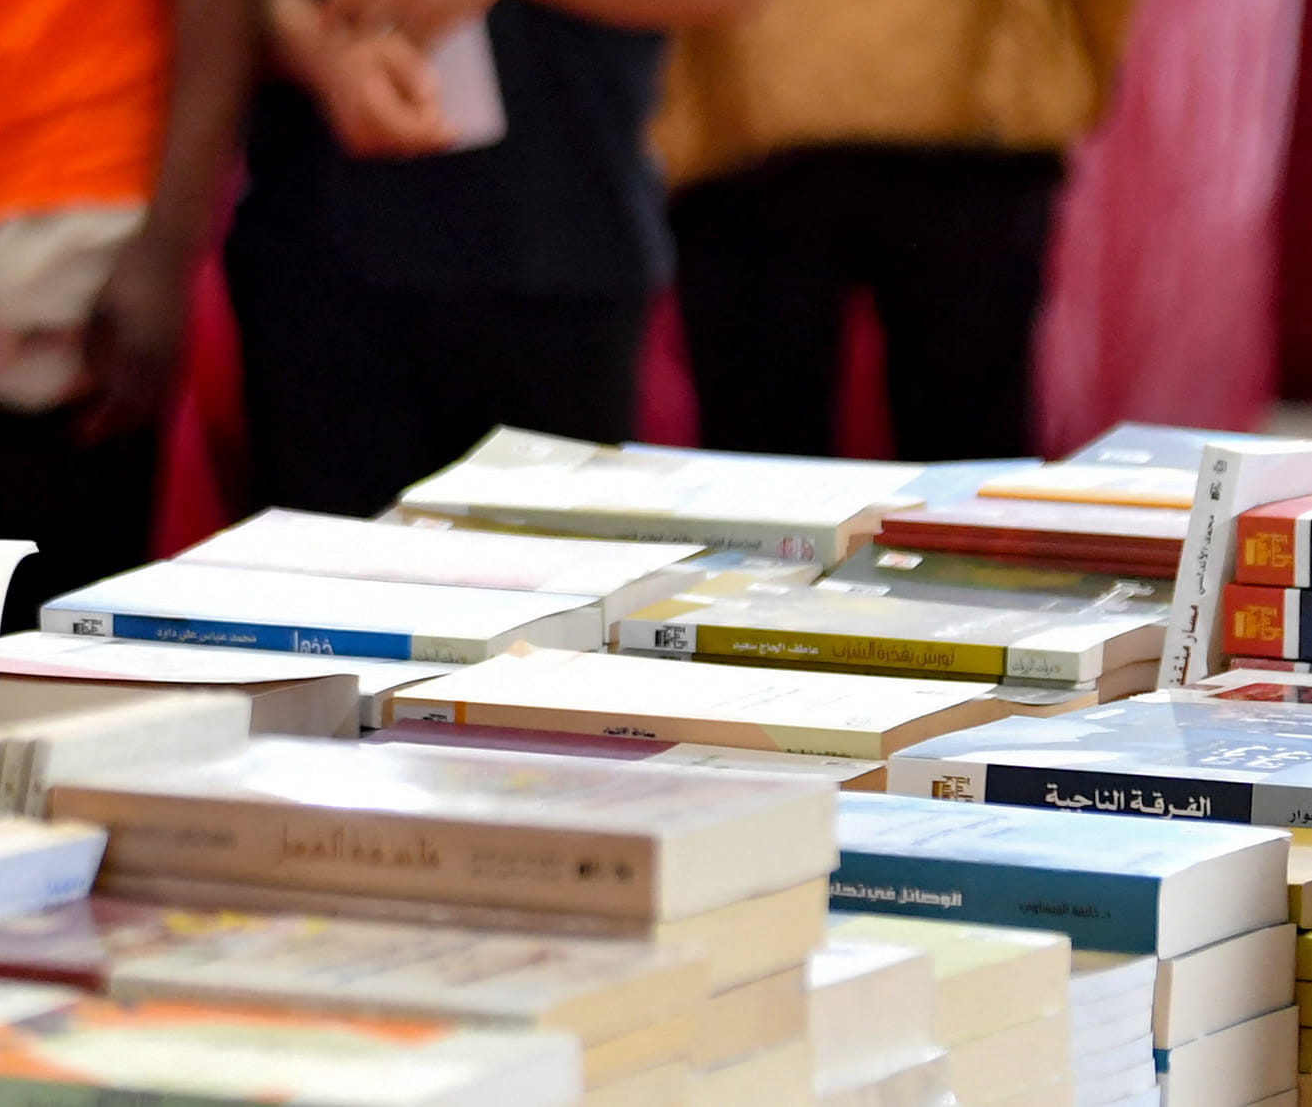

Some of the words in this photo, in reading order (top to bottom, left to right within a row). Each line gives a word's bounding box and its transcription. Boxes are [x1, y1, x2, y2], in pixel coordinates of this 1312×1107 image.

[1205, 515, 1216, 546] محمد
[1182, 604, 1199, 644] مسار
[1045, 781, 1125, 813] الناجية
[1129, 790, 1211, 820] الفرقة
[1287, 809, 1312, 824] وار
[863, 887, 896, 902] في
[897, 887, 963, 909] الوصائل
